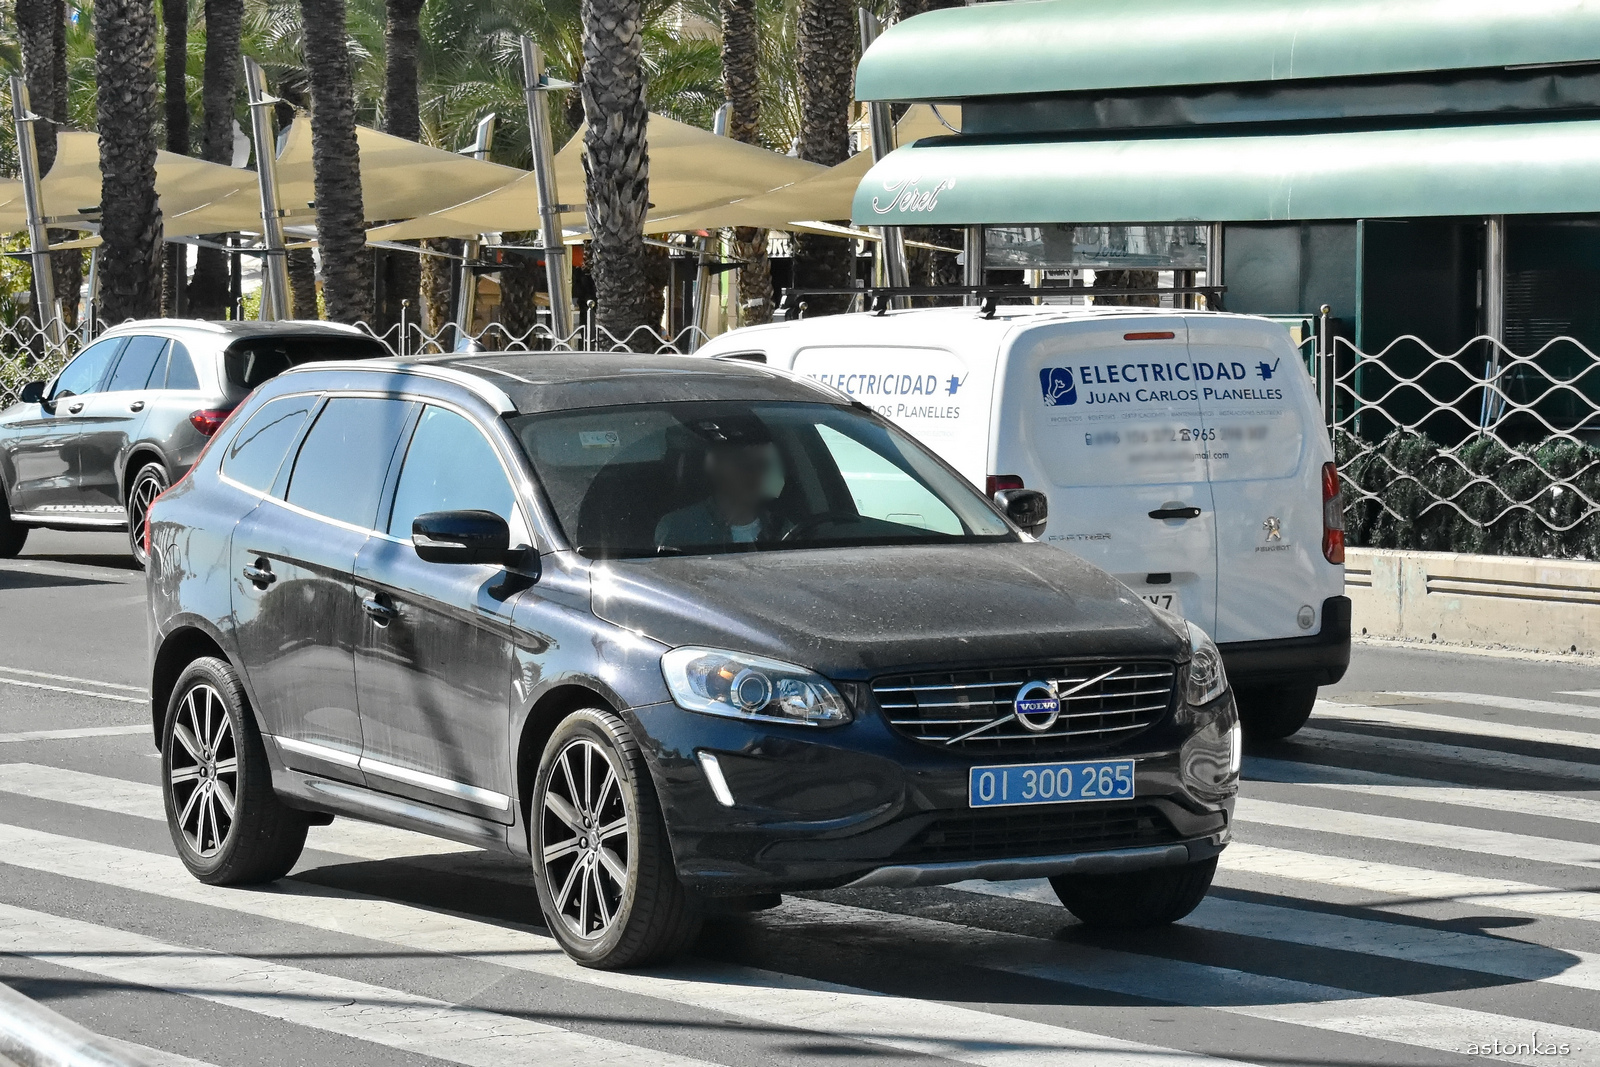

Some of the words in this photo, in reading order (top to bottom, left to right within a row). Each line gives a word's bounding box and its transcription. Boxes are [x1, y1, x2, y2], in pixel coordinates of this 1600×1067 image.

[1080, 362, 1246, 384] ELECTRICIDAD
[1192, 428, 1217, 442] 965
[1020, 702, 1058, 711] VOLVO
[1022, 768, 1072, 798] 300
[1081, 765, 1131, 796] 265
